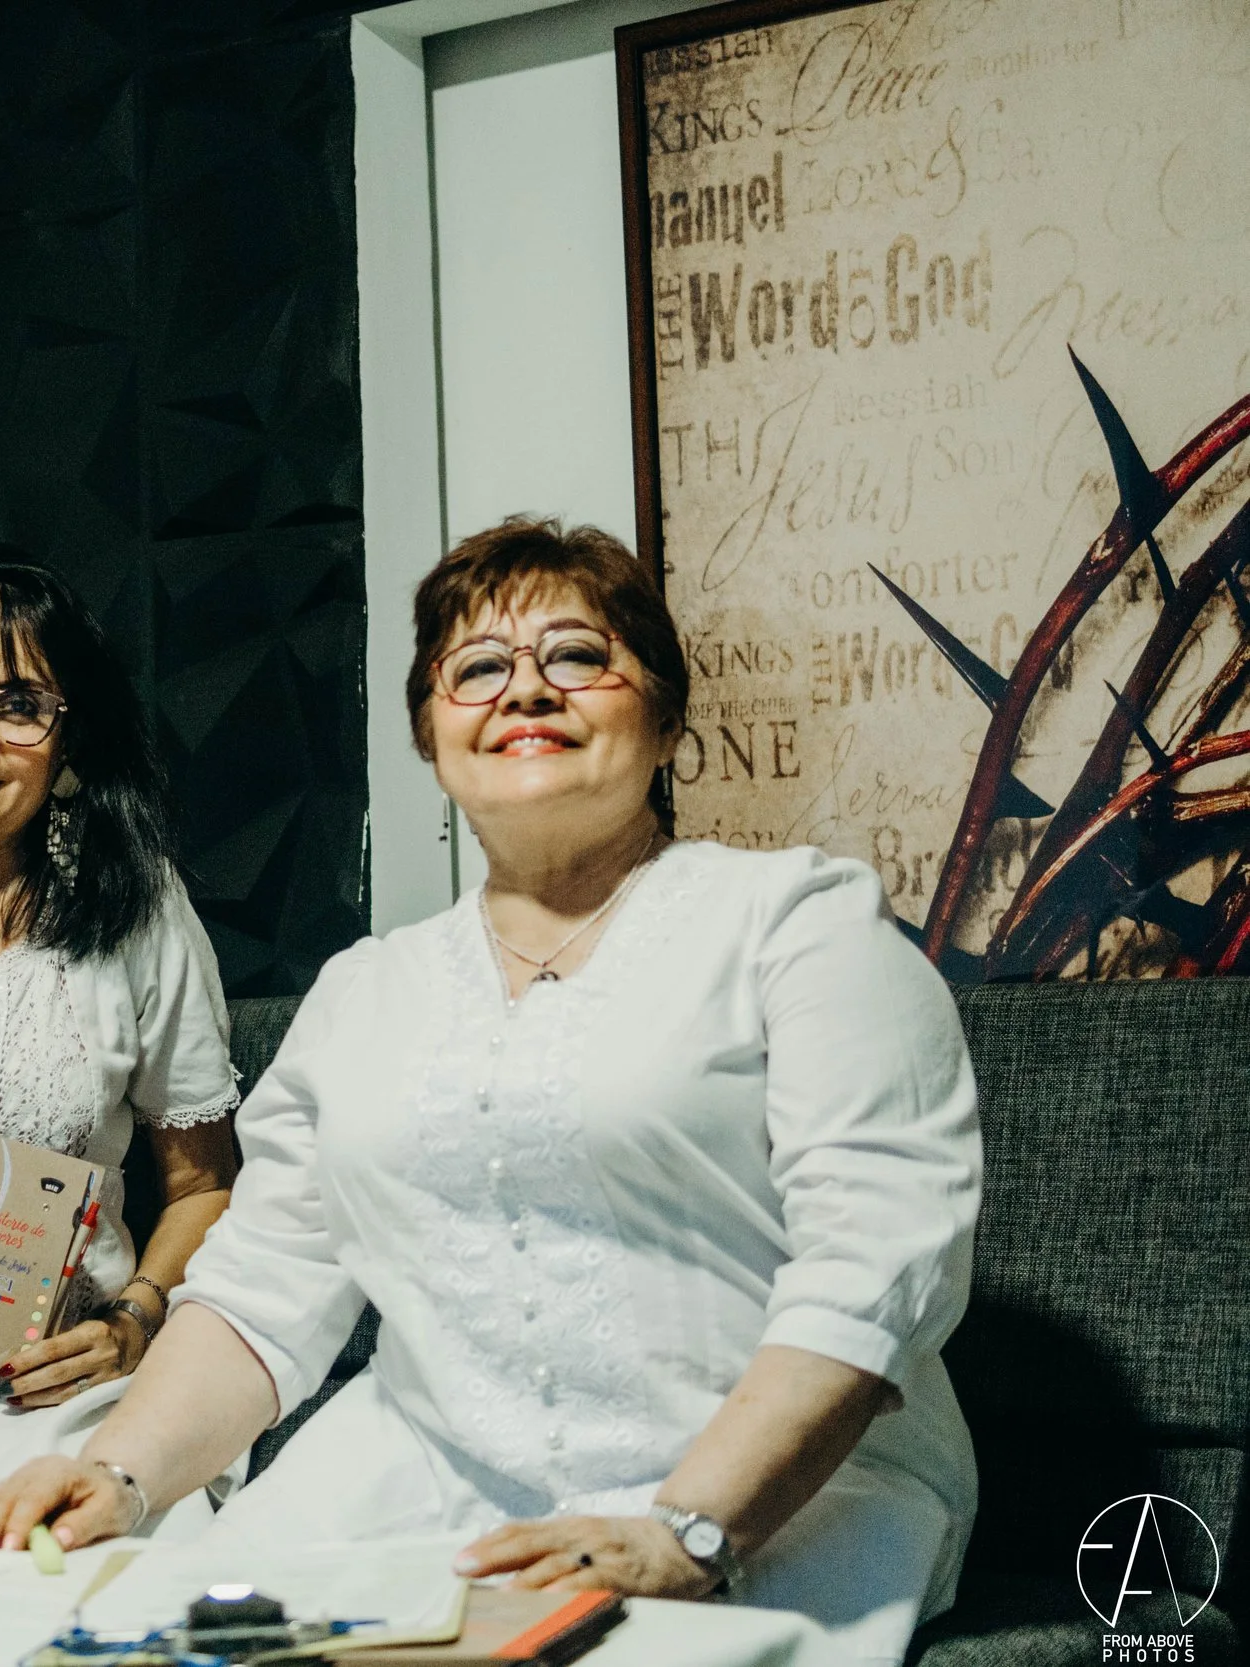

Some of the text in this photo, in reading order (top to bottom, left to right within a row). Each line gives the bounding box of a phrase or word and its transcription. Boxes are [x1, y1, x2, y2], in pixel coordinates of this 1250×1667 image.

[688, 249, 839, 371] Word
[884, 225, 994, 346] God
[673, 719, 803, 787] ONE
